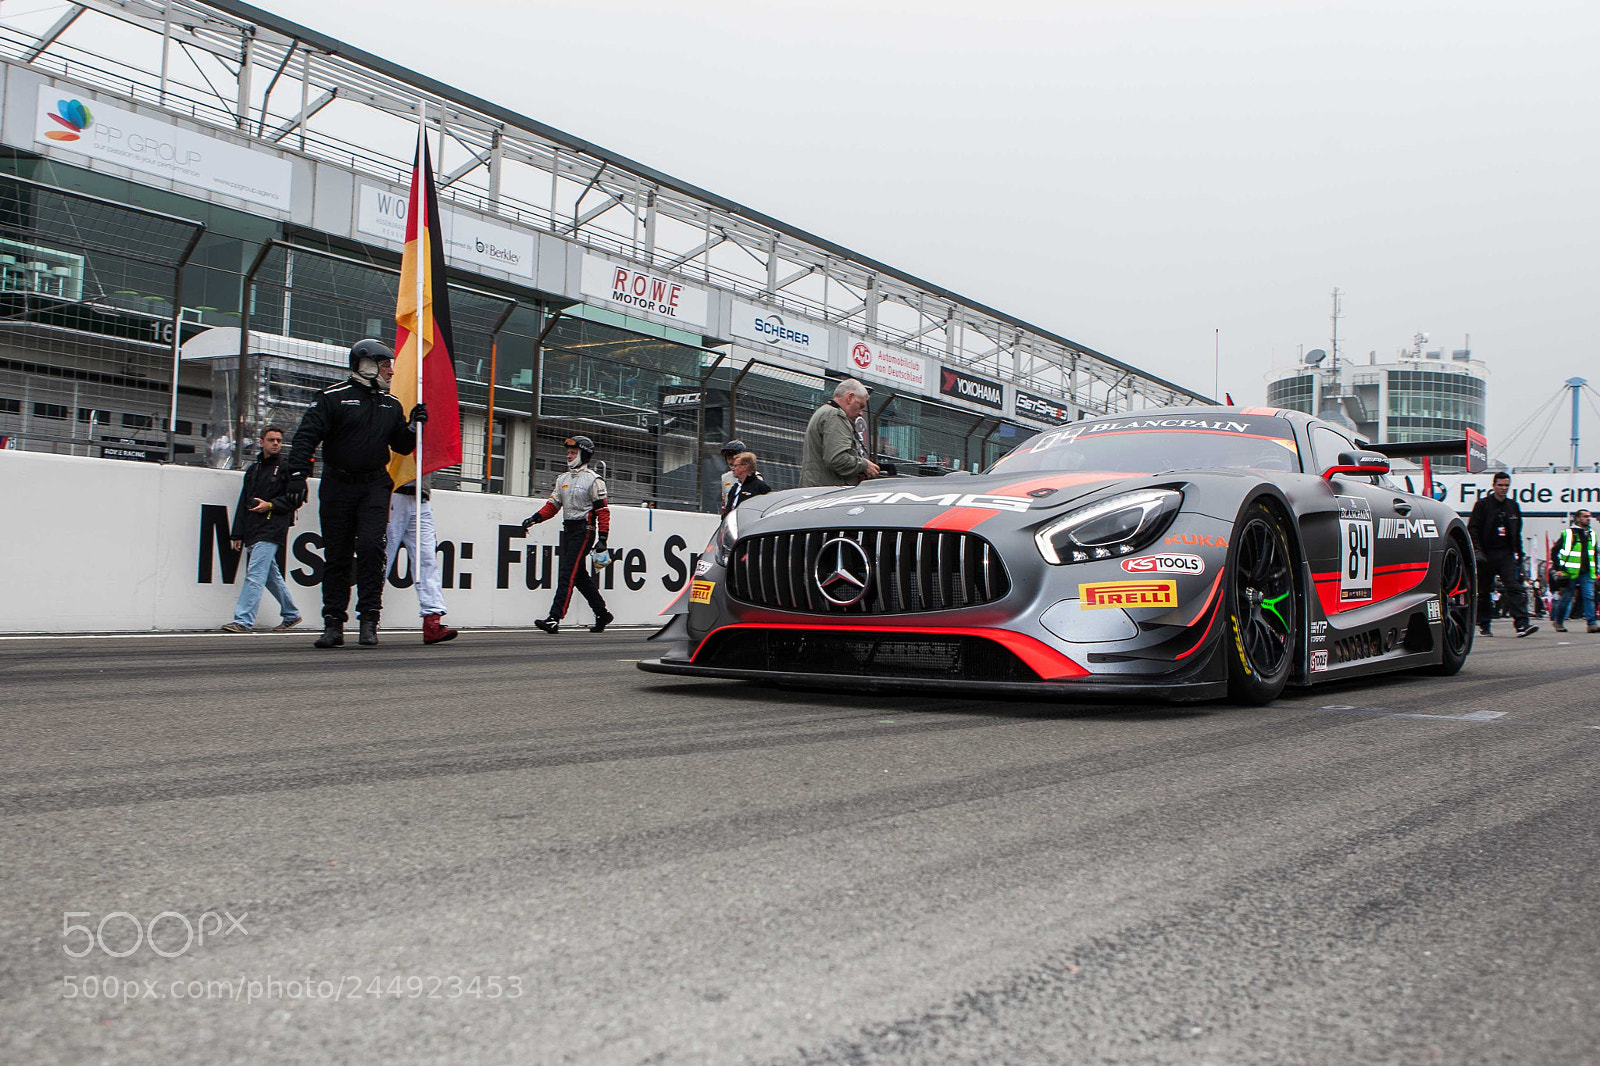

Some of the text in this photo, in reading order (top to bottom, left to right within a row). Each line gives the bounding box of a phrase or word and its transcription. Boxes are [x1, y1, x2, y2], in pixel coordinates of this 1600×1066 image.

[95, 123, 202, 166] PP GROUP
[489, 244, 519, 263] Berkley
[613, 267, 682, 307] ROWE
[612, 291, 676, 317] MOTOR OIL
[151, 321, 173, 343] 16
[755, 317, 810, 346] SCHERER
[877, 350, 920, 371] Automobilclub
[875, 364, 923, 384] von Deutschland
[956, 377, 1002, 405] YOKOHAMA
[636, 414, 648, 427] 15
[1088, 419, 1252, 433] BLANCPAIN
[826, 492, 1034, 513] AMG
[1560, 487, 1600, 503] am
[1388, 518, 1440, 539] AMG
[1165, 533, 1229, 548] KUKA
[496, 524, 648, 591] Fure
[1348, 522, 1370, 581] 84
[1127, 557, 1199, 571] KS TOOLS
[1085, 584, 1171, 606] PIRELLI
